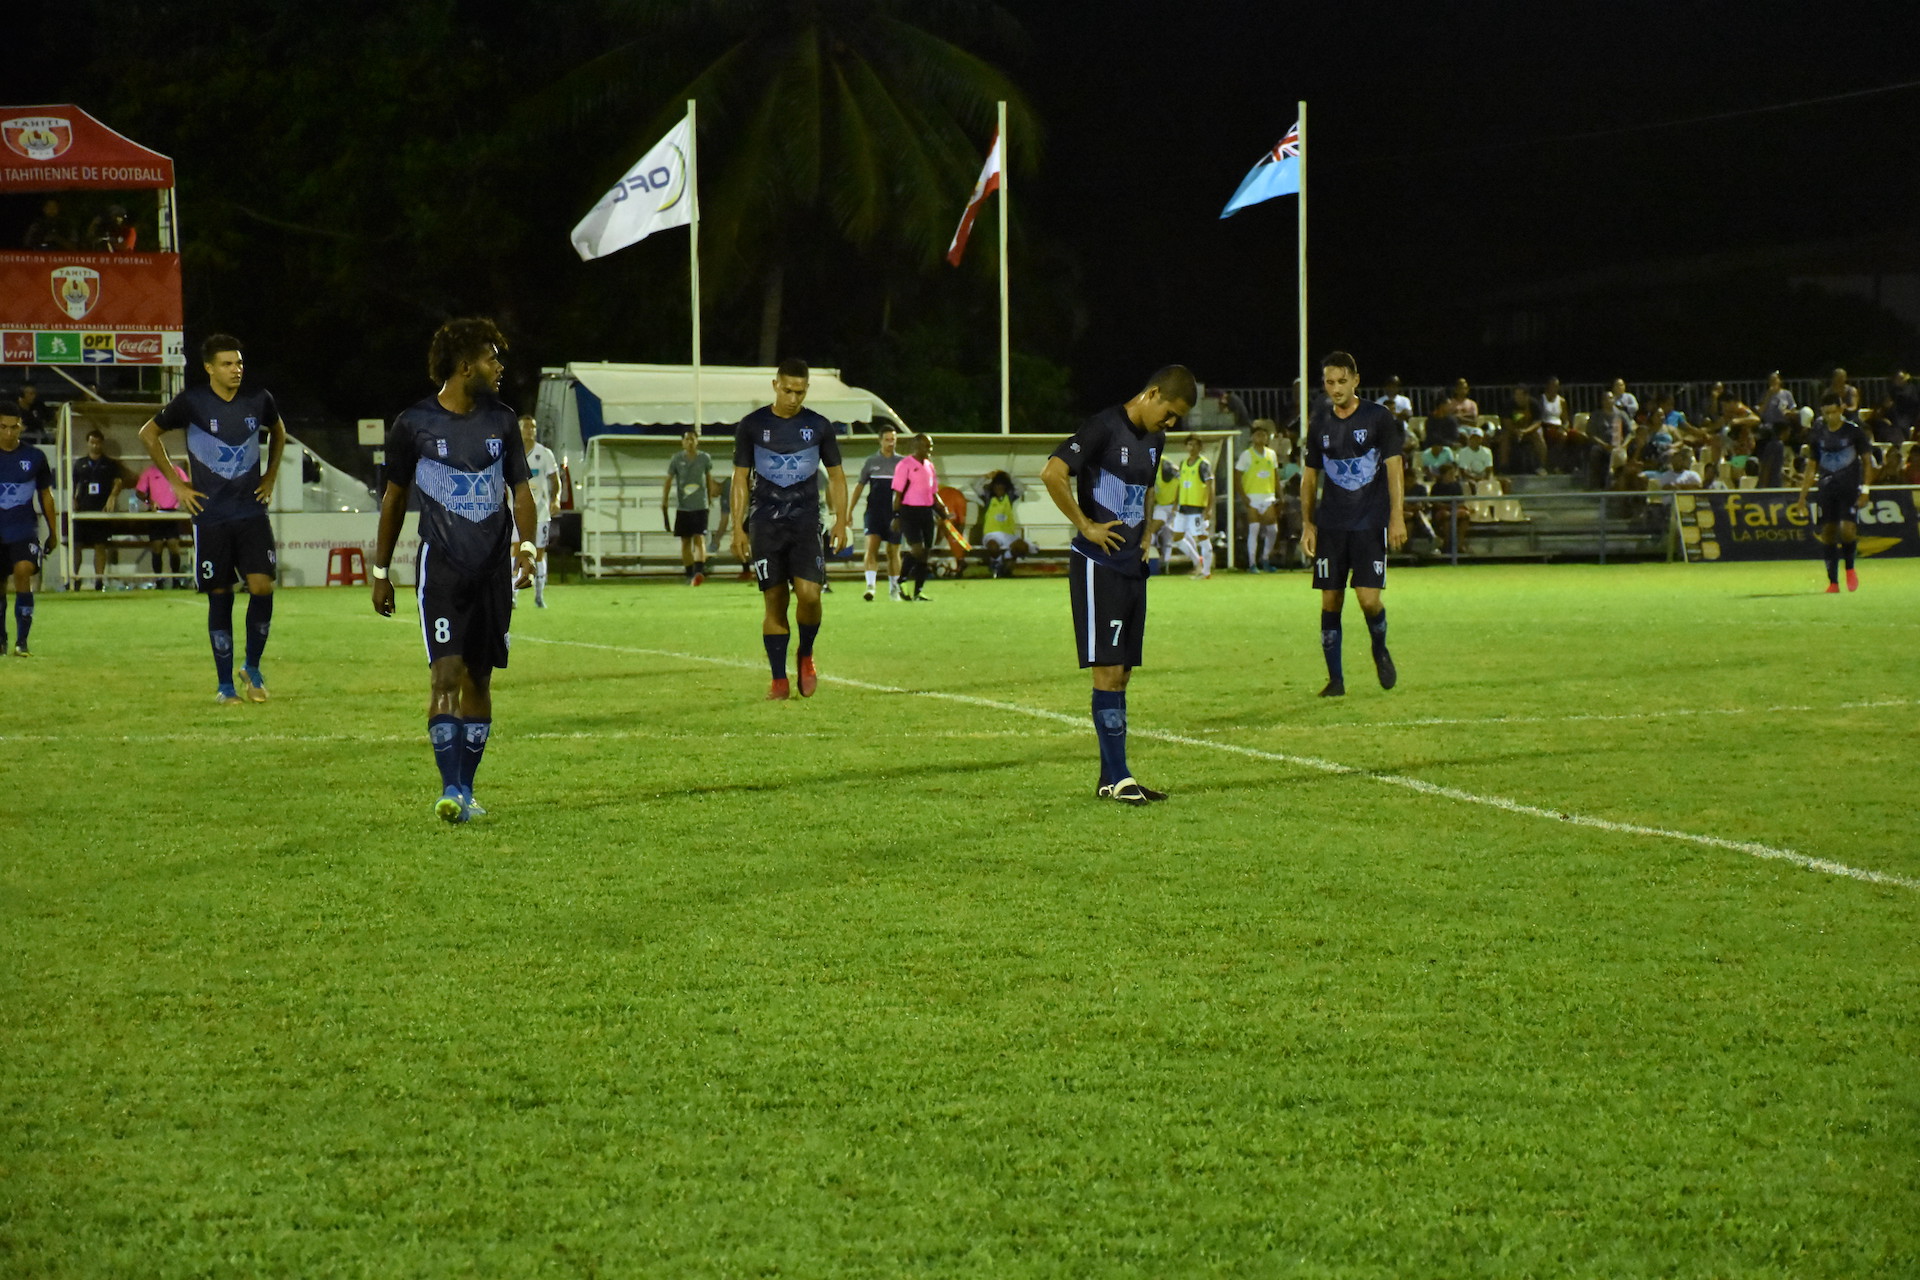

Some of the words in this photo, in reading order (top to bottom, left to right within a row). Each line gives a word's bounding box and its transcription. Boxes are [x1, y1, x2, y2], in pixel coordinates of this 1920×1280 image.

[4, 166, 79, 181] TAHITIENNE
[82, 166, 98, 180] DE
[102, 167, 164, 181] FOOTBALL
[83, 335, 112, 347] OPT
[287, 540, 301, 549] en
[1731, 529, 1751, 542] LA
[1755, 529, 1806, 542] POSTE
[201, 560, 214, 579] 3
[754, 558, 769, 581] 17
[1316, 557, 1329, 578] 11
[434, 617, 450, 643] 8
[1109, 619, 1123, 646] 7
